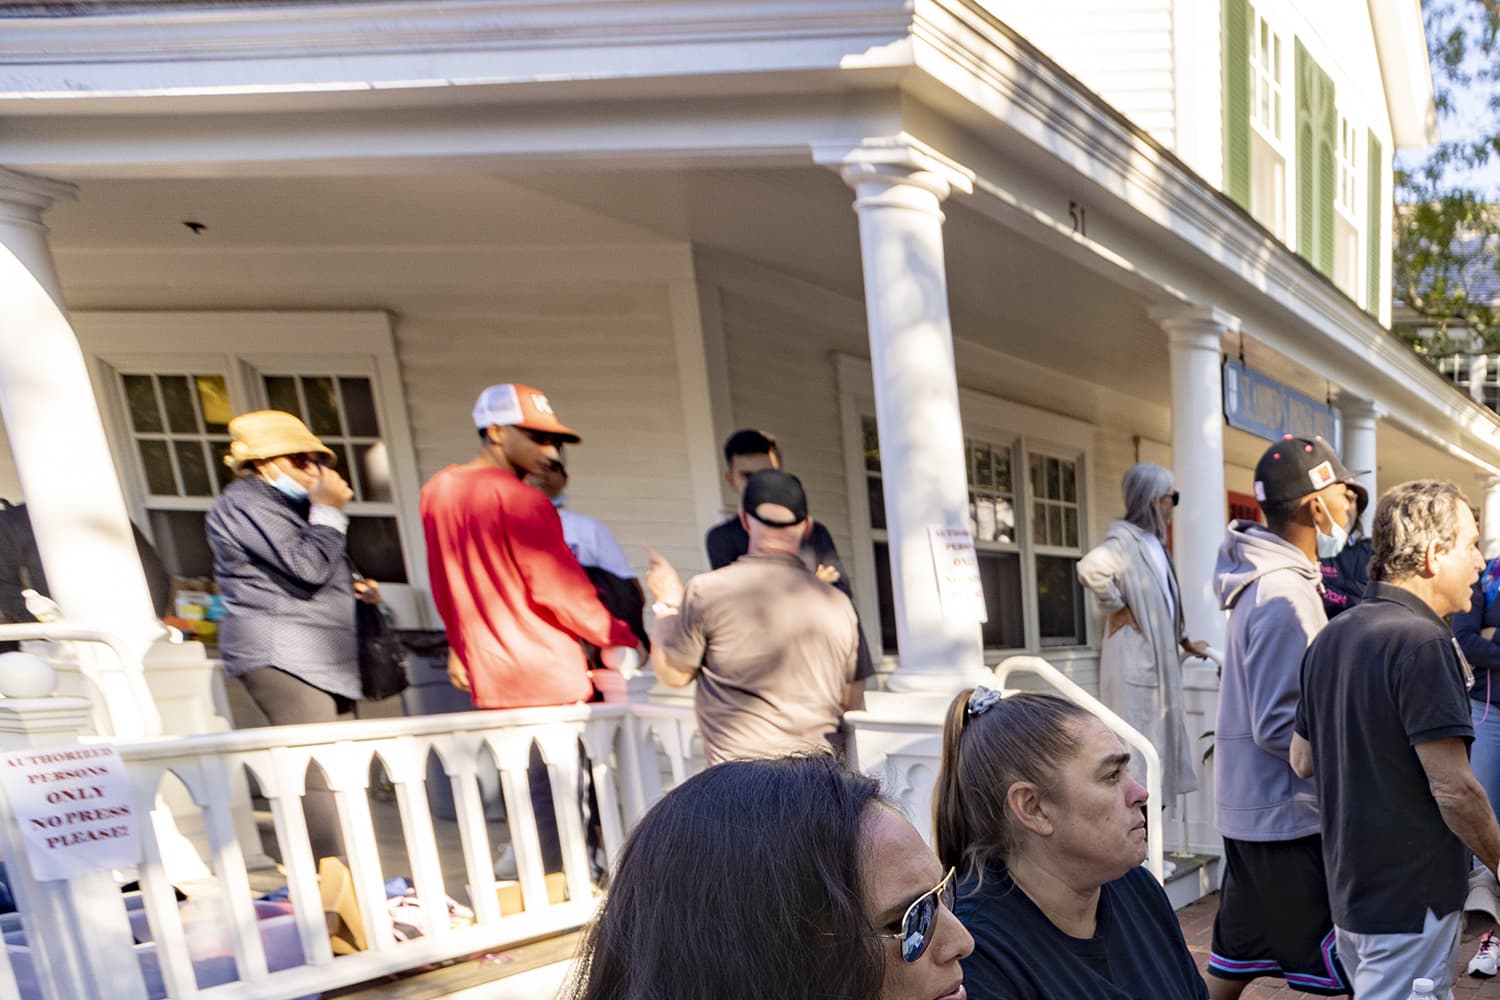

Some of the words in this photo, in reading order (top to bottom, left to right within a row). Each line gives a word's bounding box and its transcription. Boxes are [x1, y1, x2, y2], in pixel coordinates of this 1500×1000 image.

[7, 747, 113, 768] AUTHORIZED
[27, 766, 110, 784] PERSONS
[46, 785, 105, 804] ONLY
[30, 814, 63, 830] NO
[64, 805, 131, 824] PRESS
